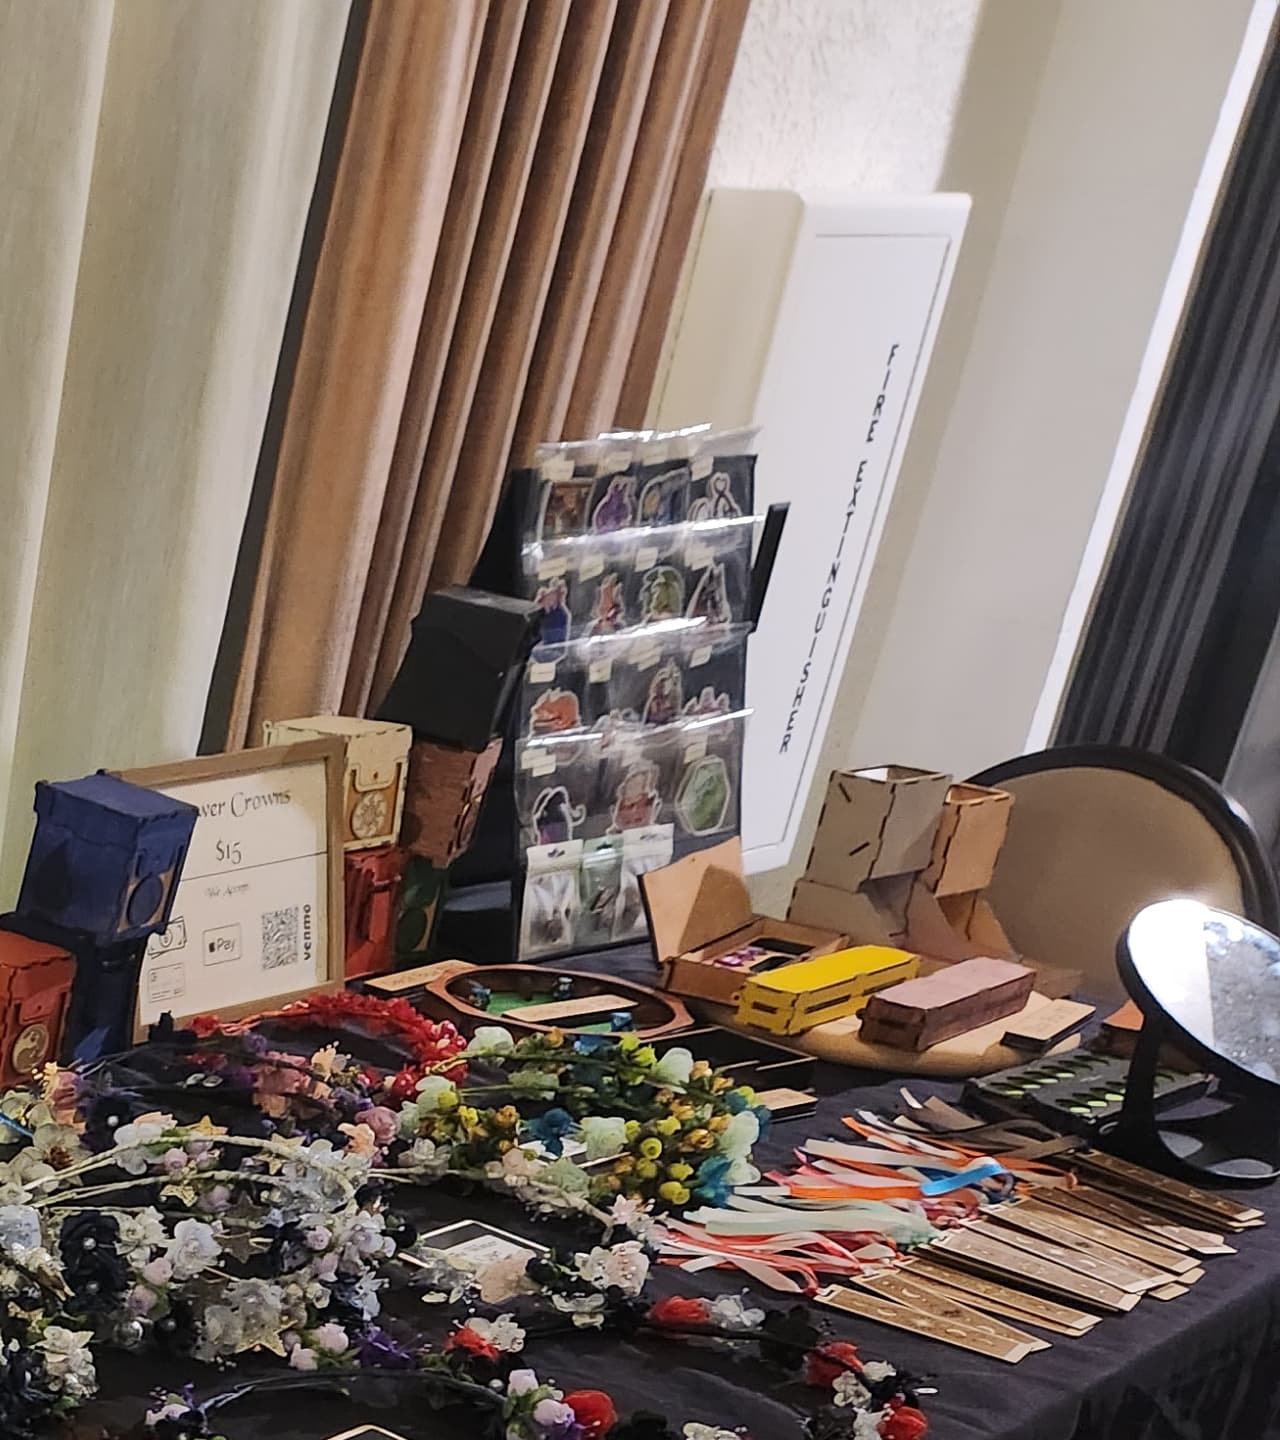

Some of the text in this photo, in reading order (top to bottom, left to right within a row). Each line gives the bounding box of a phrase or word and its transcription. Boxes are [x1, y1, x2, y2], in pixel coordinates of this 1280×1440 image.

[778, 342, 900, 755] FIRE EXTINGUISHER
[230, 788, 292, 819] Crowns
[215, 840, 243, 865] $15
[216, 938, 237, 954] Pay
[302, 903, 313, 962] venmo
